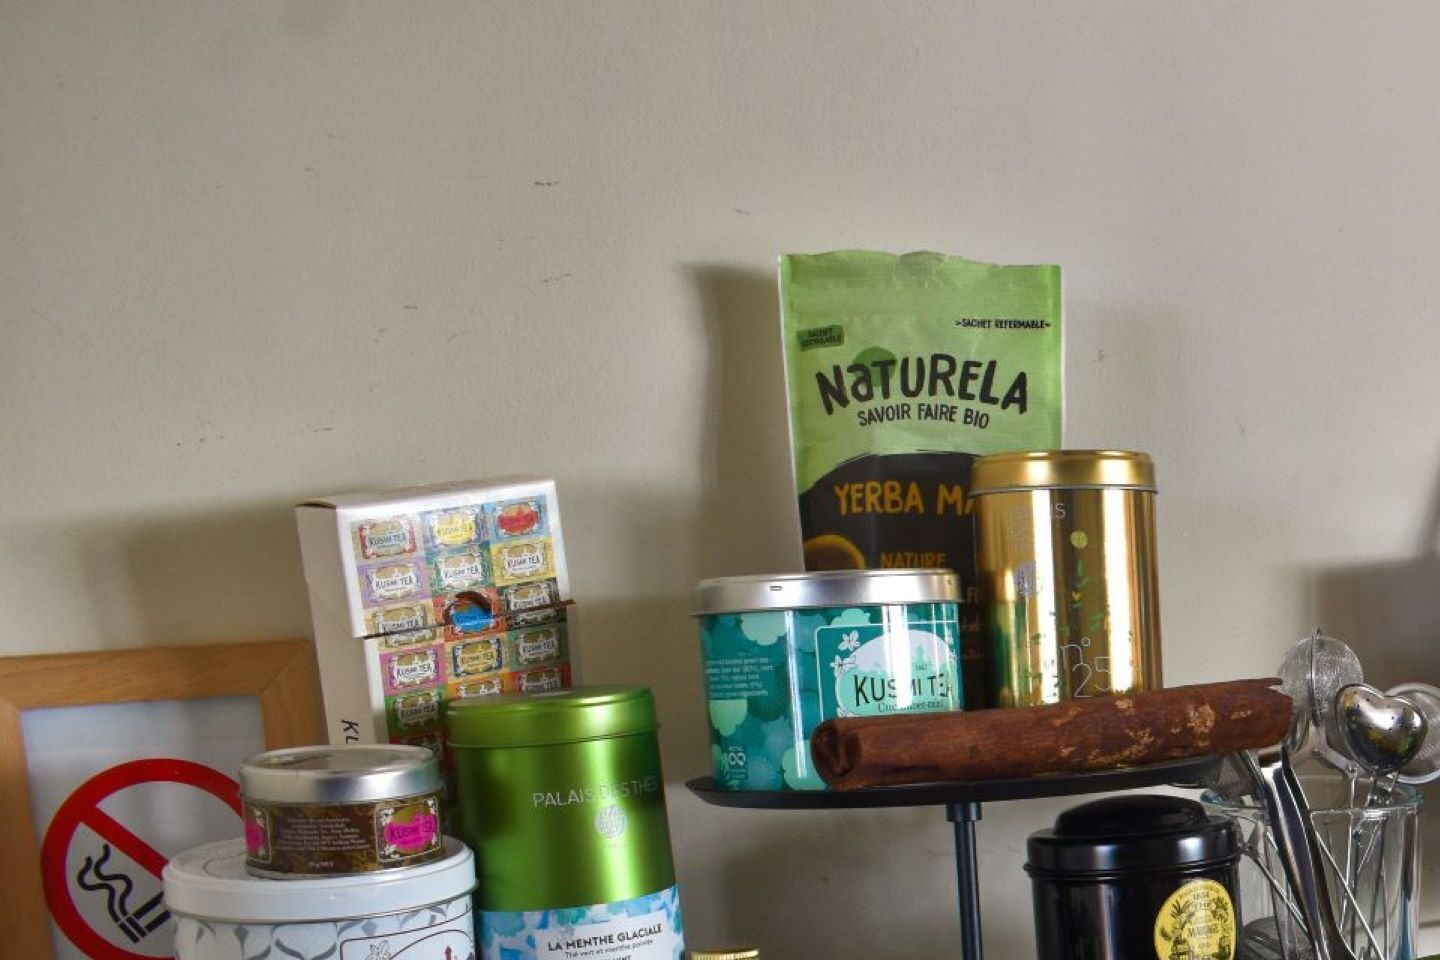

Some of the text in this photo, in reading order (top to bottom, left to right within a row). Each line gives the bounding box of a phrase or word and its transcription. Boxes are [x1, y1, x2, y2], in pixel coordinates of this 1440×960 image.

[961, 318, 1045, 329] SACHET REFERMABLE
[857, 403, 989, 429] SAVOIR FAIRE BIO
[833, 480, 925, 517] YERBA
[880, 552, 946, 569] NATURE
[533, 787, 594, 808] PALAIS
[548, 924, 662, 951] LA MENTHE GLACIALE
